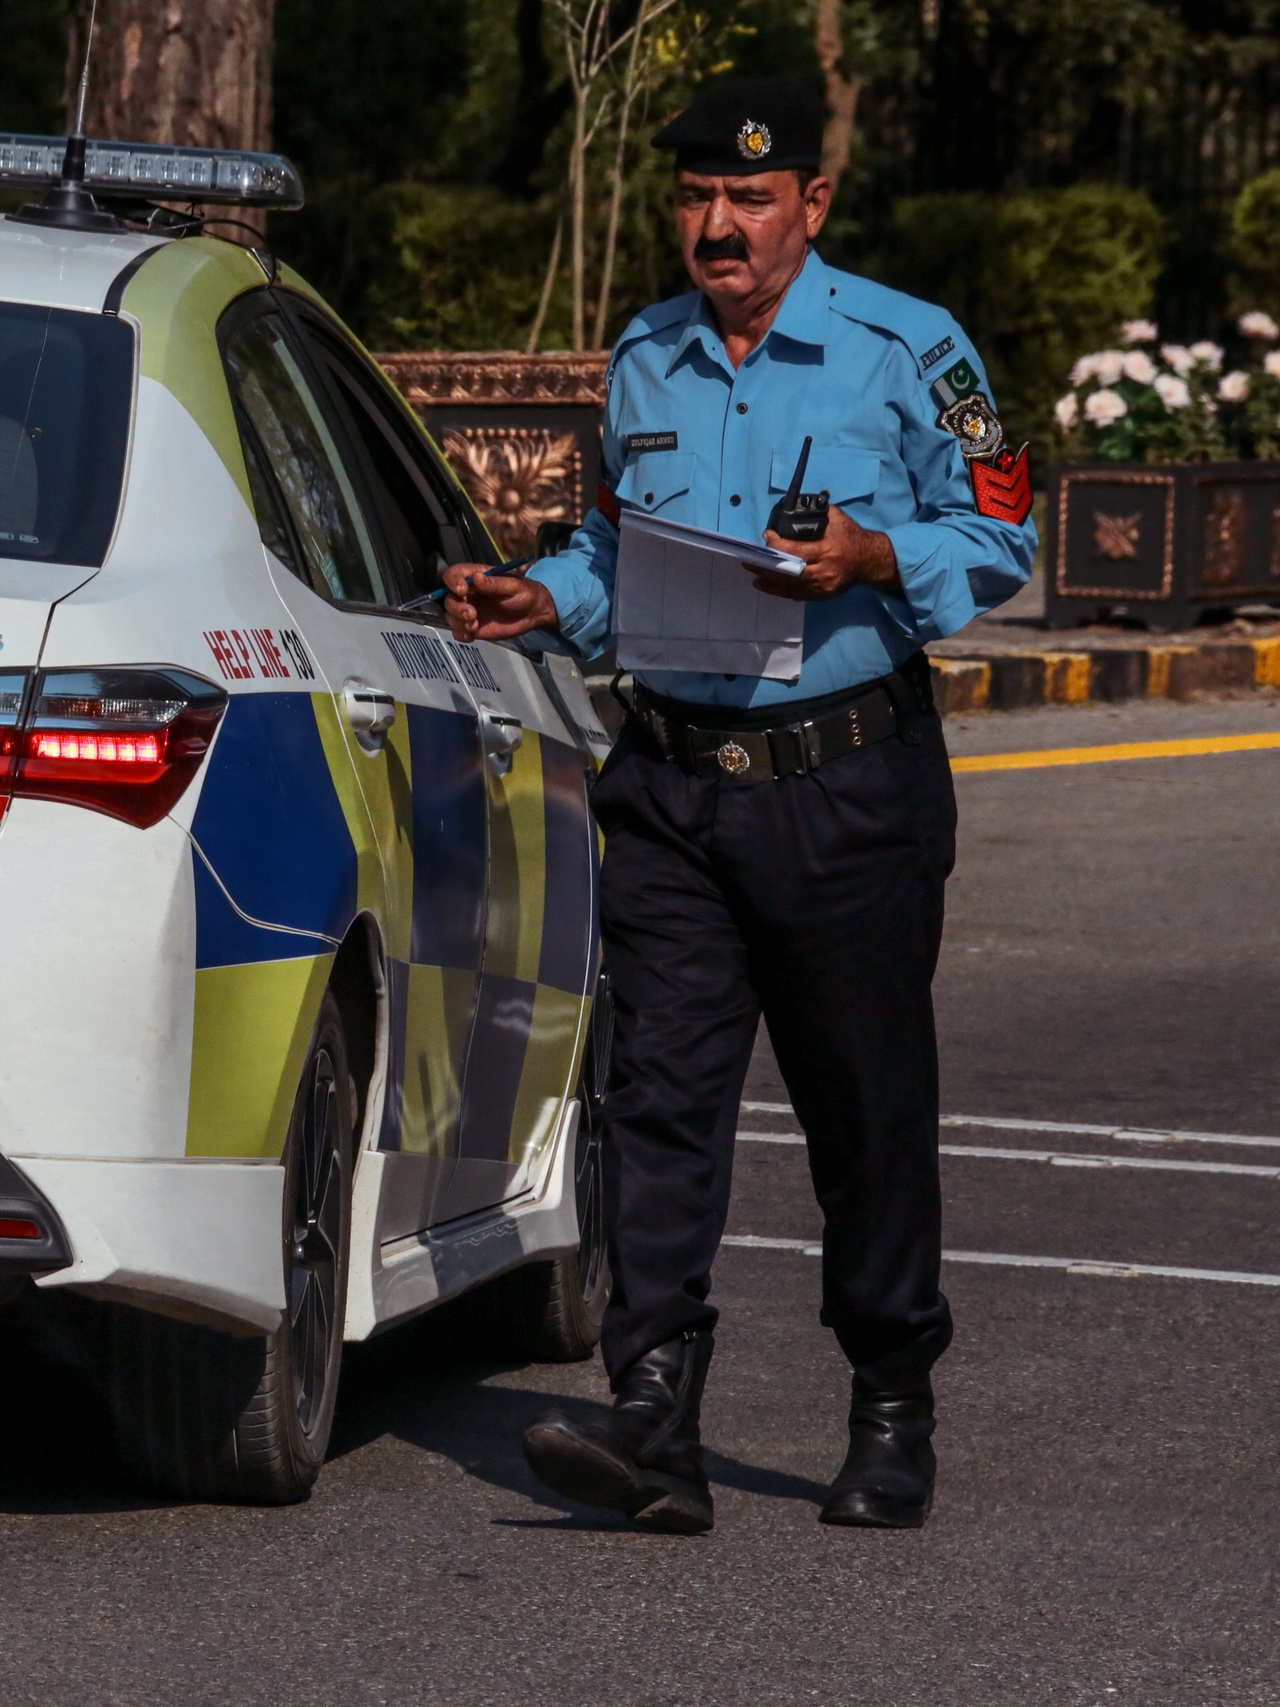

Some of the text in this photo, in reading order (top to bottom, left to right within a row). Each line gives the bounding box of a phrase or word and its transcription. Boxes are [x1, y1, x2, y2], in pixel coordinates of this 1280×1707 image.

[202, 629, 316, 680] HELP LINE 130
[380, 631, 502, 693] MOTORWAY PATROL
